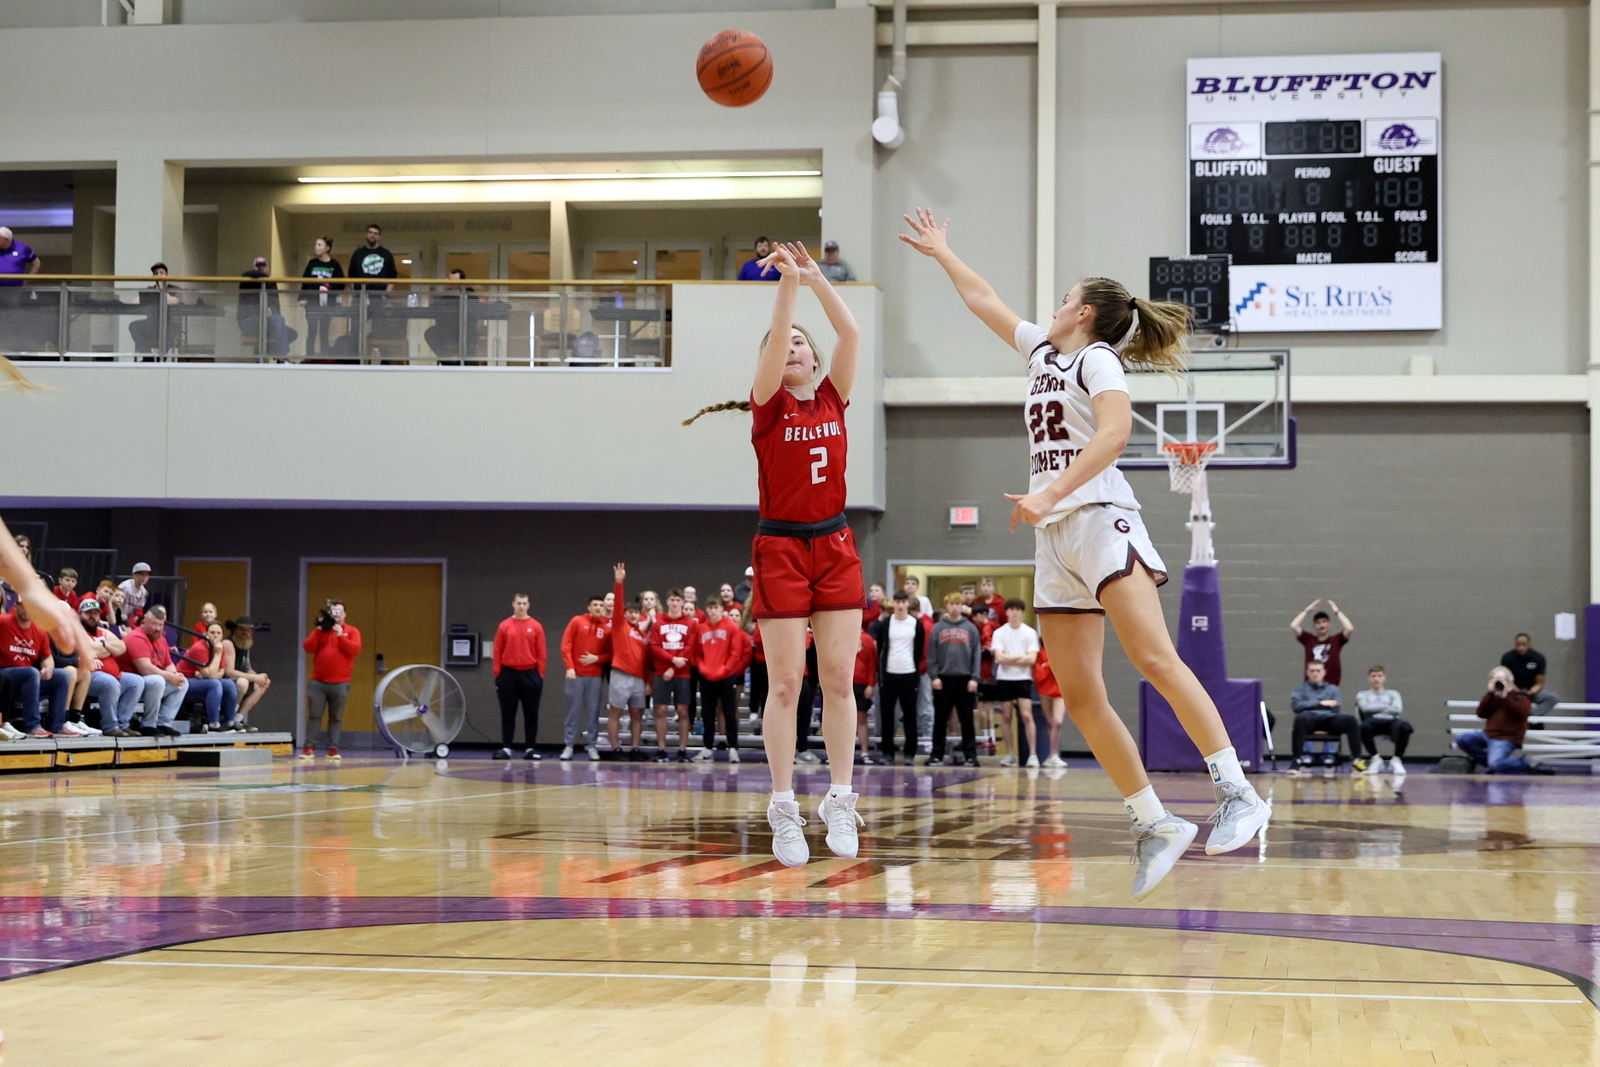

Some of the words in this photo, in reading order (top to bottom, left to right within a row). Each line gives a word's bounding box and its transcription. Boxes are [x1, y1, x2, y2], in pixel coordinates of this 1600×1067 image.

[1190, 71, 1437, 95] BLUFFTON
[1205, 91, 1407, 103] UNIVERSITY
[1195, 160, 1267, 177] BLUFFTON
[1373, 156, 1423, 174] GUEST
[1294, 166, 1331, 179] PERIOD
[1200, 213, 1233, 226] FOULS
[1241, 212, 1270, 225] T.O.L.
[1278, 211, 1317, 224] PLAYER
[1320, 211, 1346, 223] FOUL
[1355, 210, 1383, 223] T.O.L.
[1394, 209, 1428, 222] FOULS
[1296, 252, 1332, 264] MATCH
[1394, 251, 1428, 263] SCORE
[1284, 307, 1329, 318] HEALTH
[1331, 306, 1392, 318] PARTNERS
[1029, 400, 1071, 444] 22
[809, 446, 828, 485] 2
[1114, 518, 1131, 534] G
